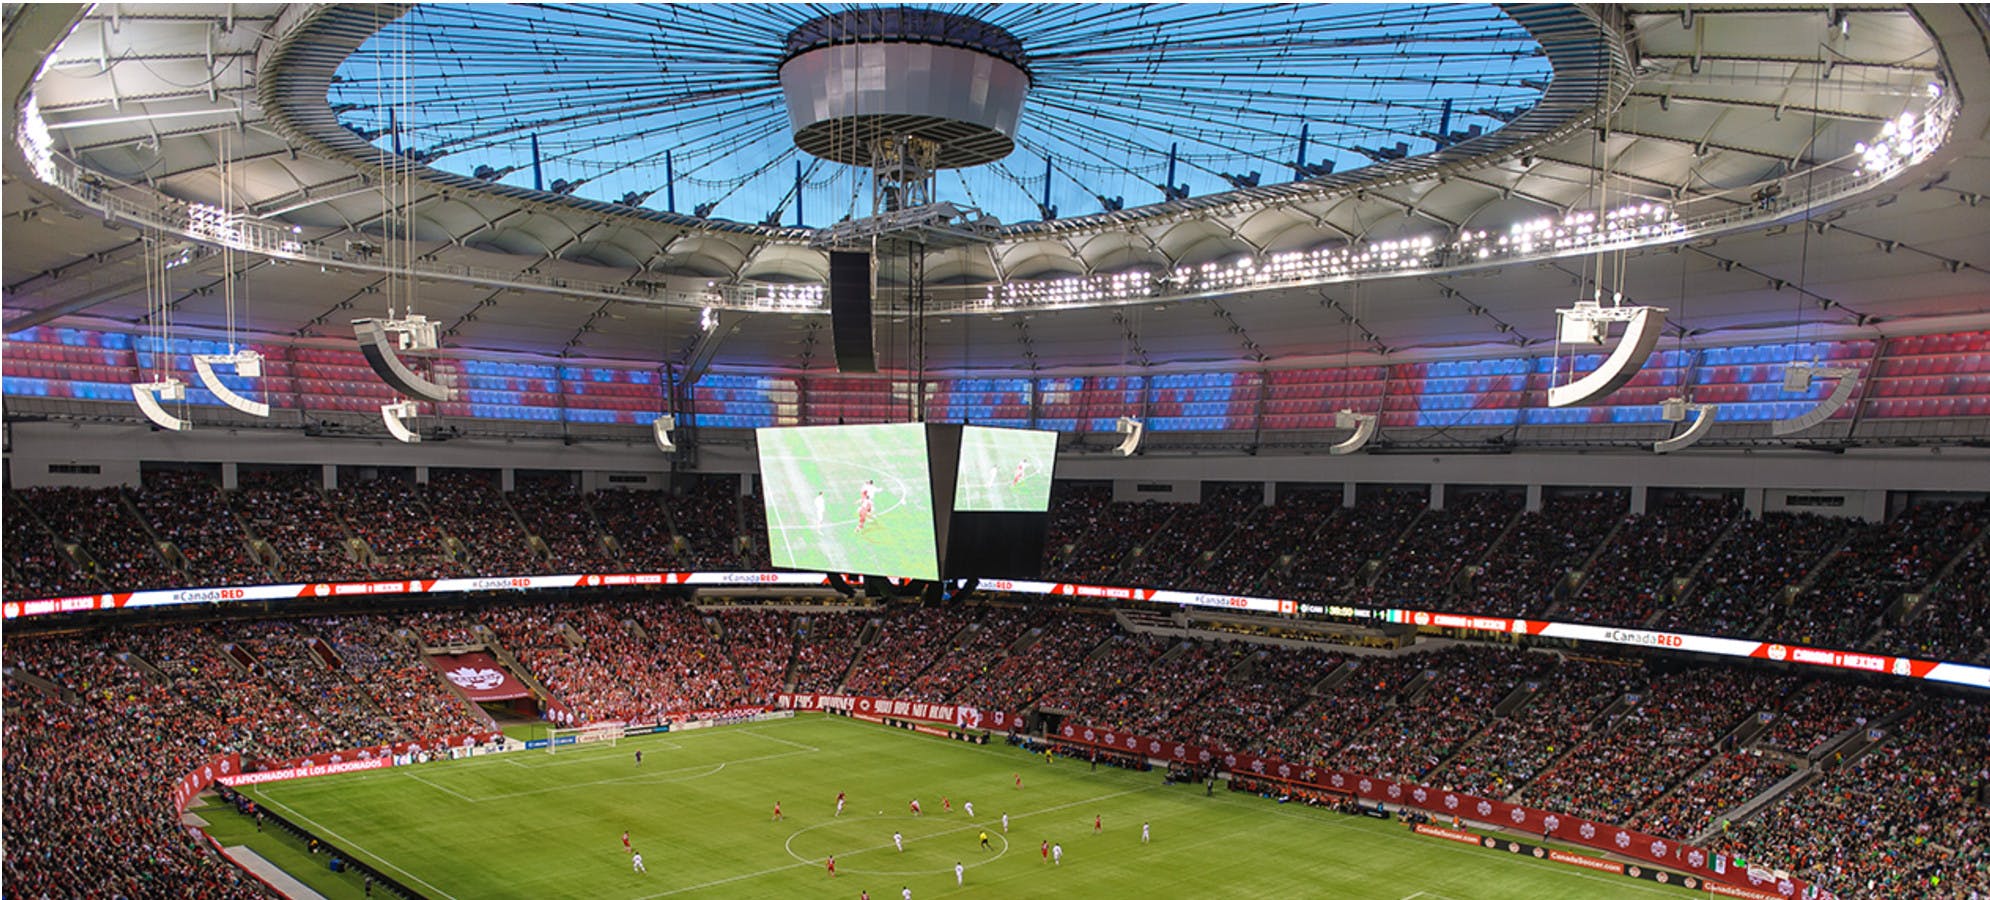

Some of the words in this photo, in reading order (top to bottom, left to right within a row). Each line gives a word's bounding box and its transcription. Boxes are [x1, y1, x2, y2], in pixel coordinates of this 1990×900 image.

[173, 589, 244, 601] #CanadaRED
[1604, 630, 1682, 647] #CanadaRED
[235, 770, 295, 785] AFICIONADOS
[296, 767, 308, 777] DE
[310, 765, 325, 775] LOS
[327, 760, 382, 774] AFICIONADOS
[1551, 851, 1621, 872] CanadaSoccer.com
